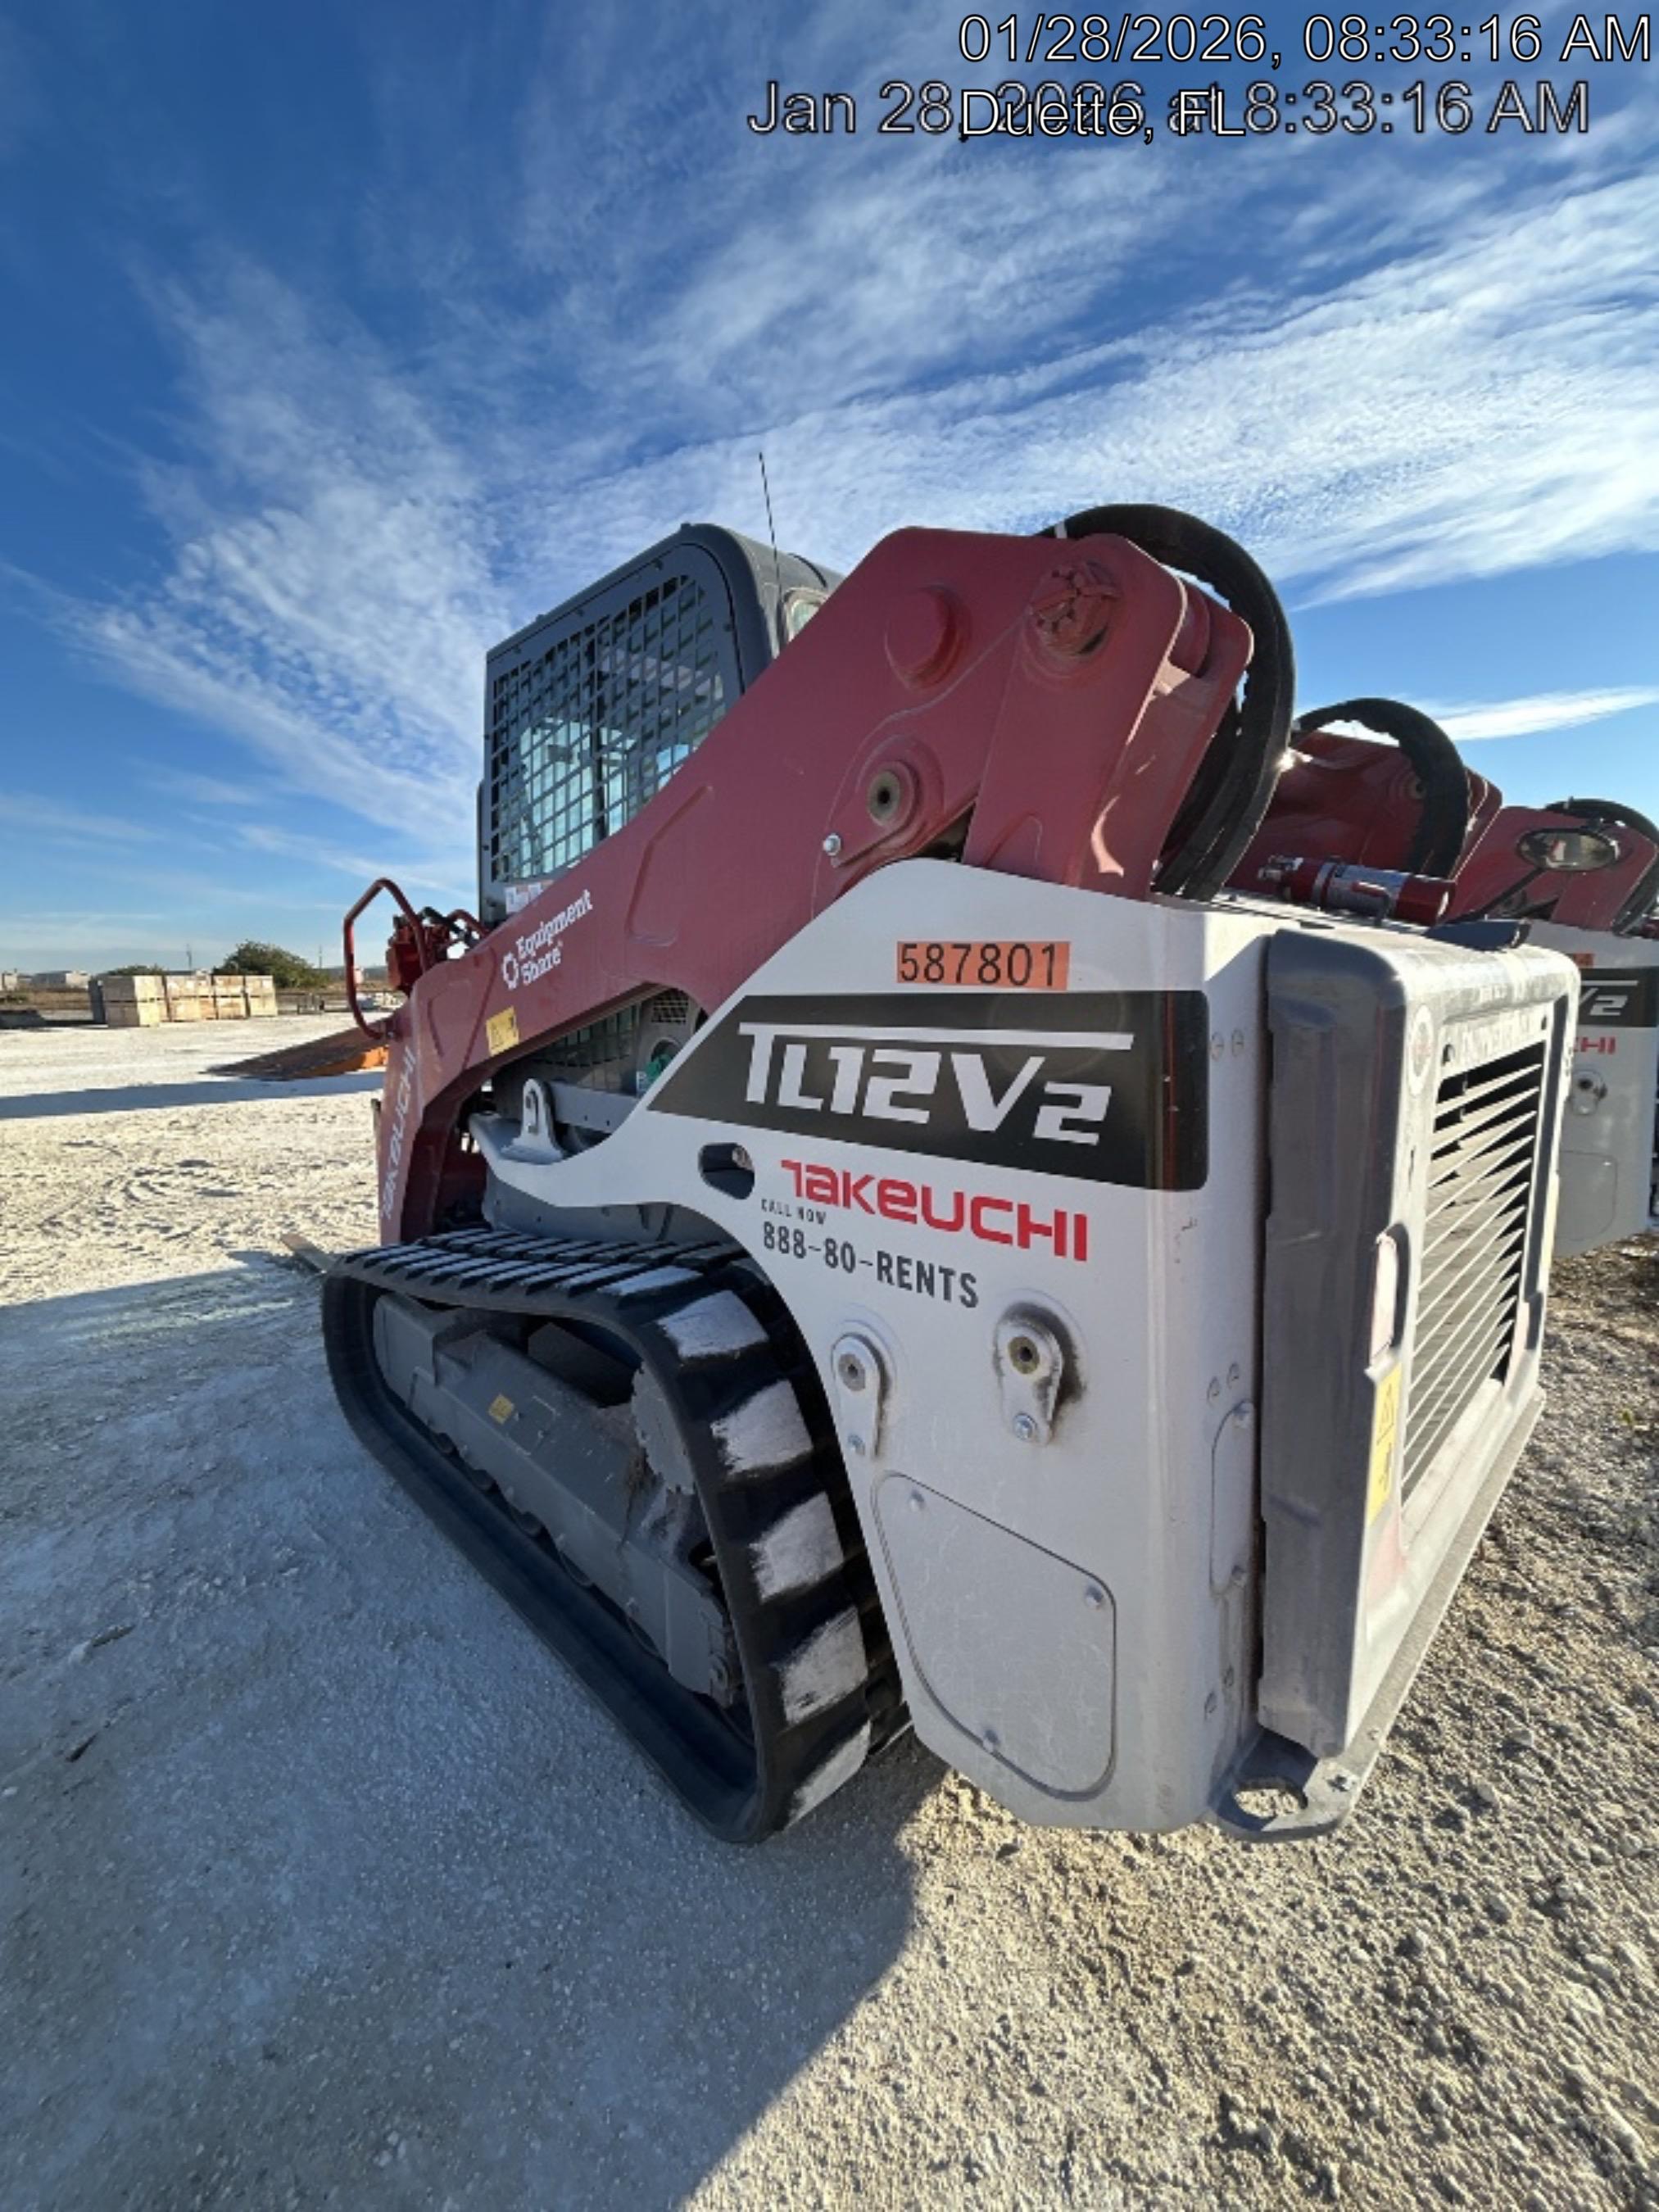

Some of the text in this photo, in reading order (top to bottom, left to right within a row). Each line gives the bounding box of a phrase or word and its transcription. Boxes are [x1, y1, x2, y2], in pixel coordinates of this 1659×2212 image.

[515, 889, 593, 960] Equipment
[521, 947, 561, 986] Share
[900, 943, 1057, 986] 587801
[739, 1022, 1134, 1145] TL12V2
[761, 1198, 827, 1225] CALL NOW
[763, 1222, 979, 1309] 888-80-RENTS
